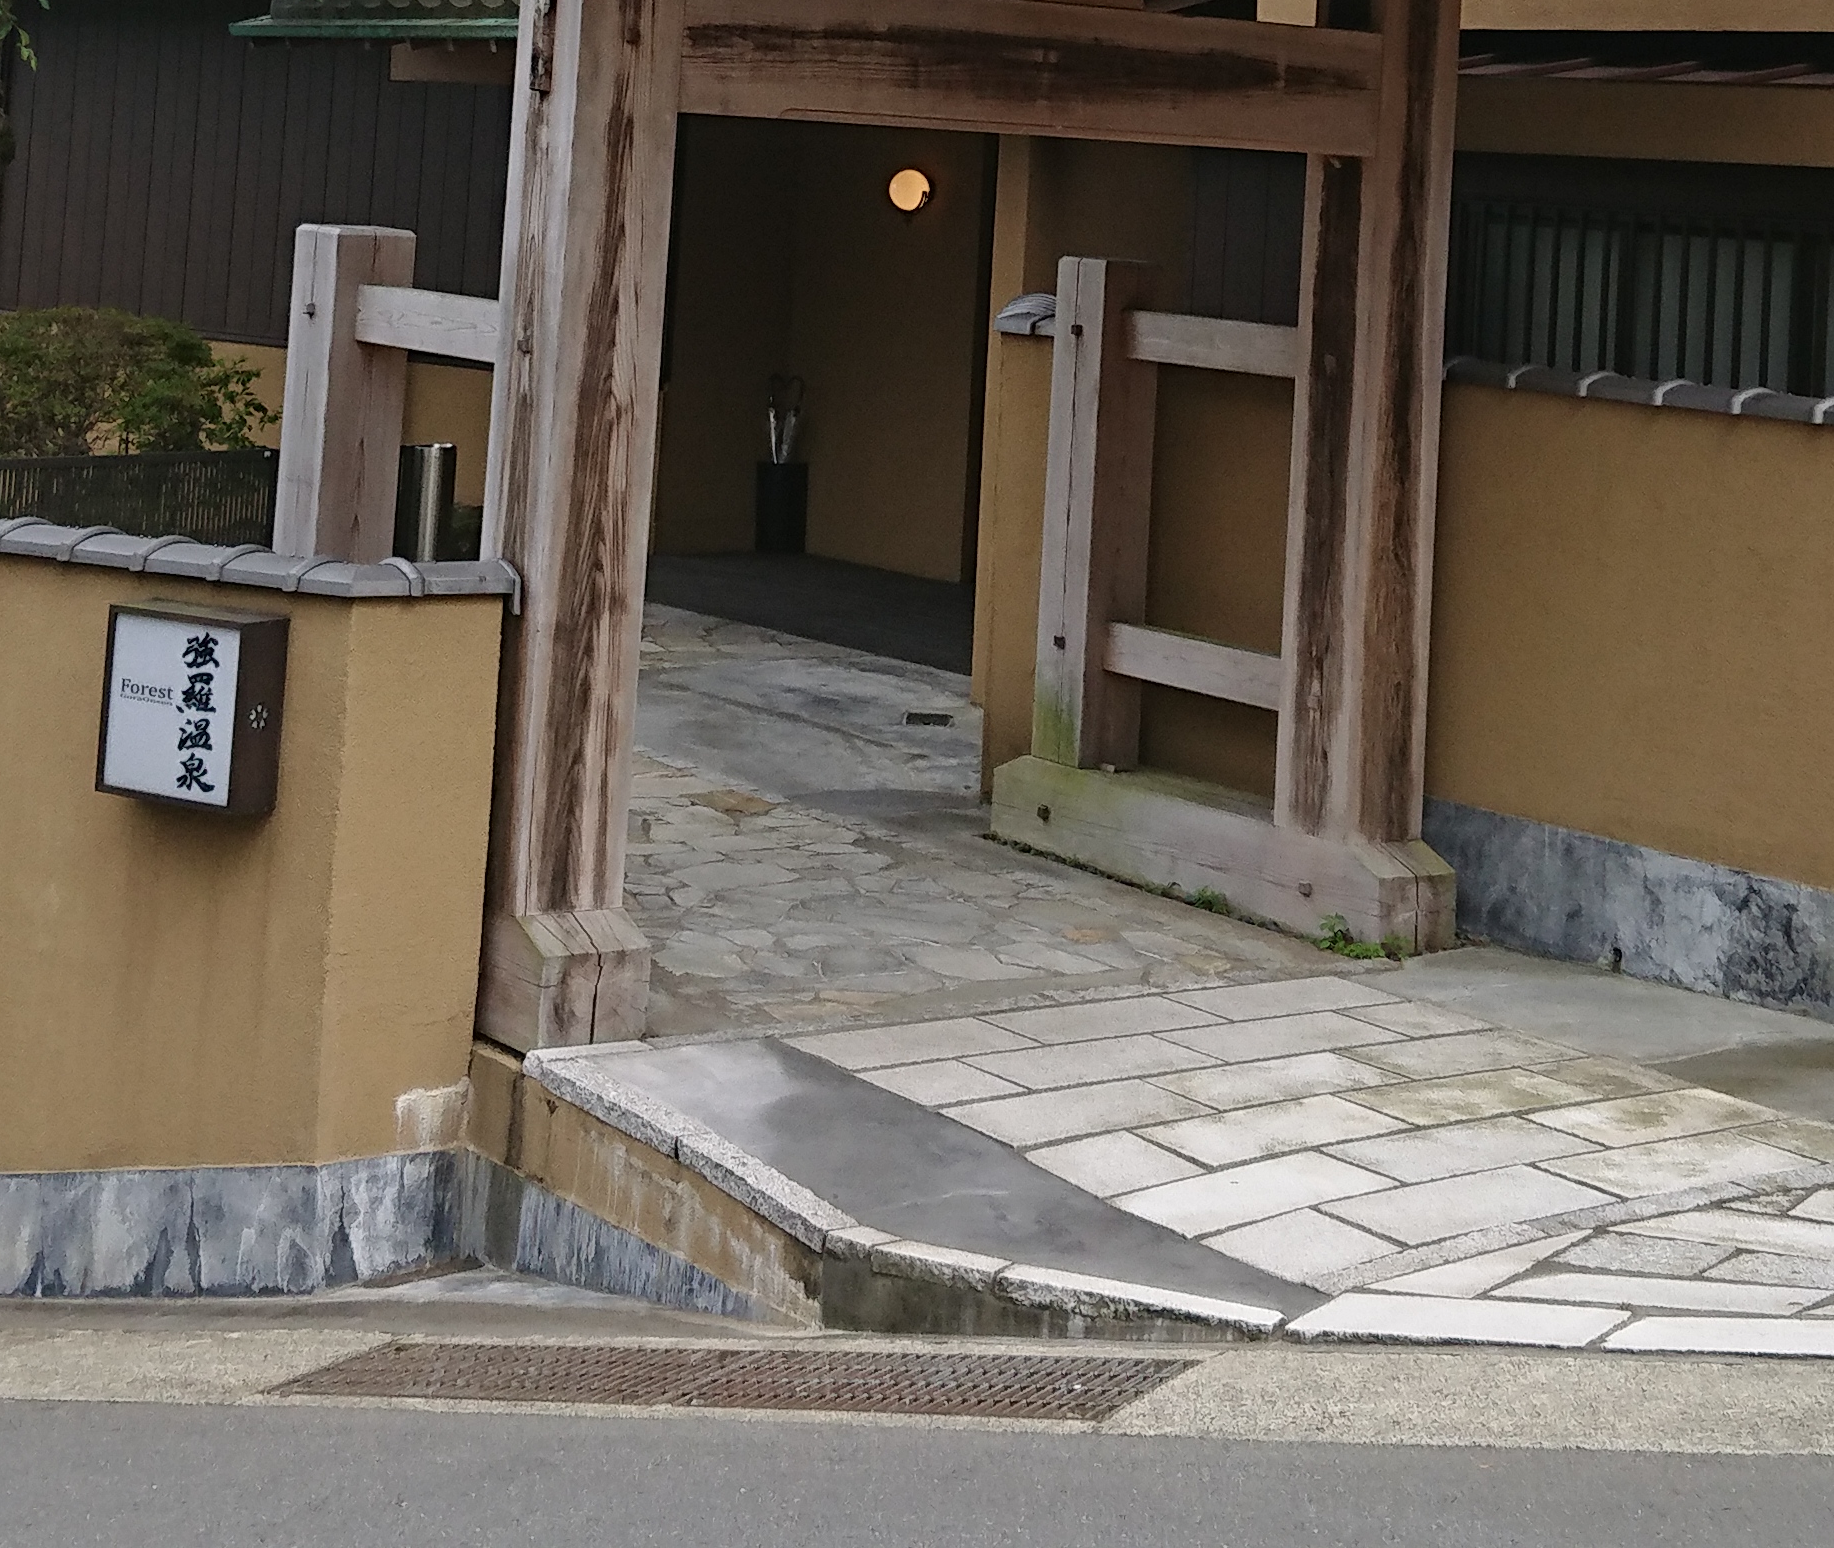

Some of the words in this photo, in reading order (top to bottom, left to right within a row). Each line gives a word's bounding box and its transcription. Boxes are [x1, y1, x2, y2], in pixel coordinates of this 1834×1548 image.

[121, 677, 174, 701] Forest
[176, 632, 220, 793] 強羅温泉
